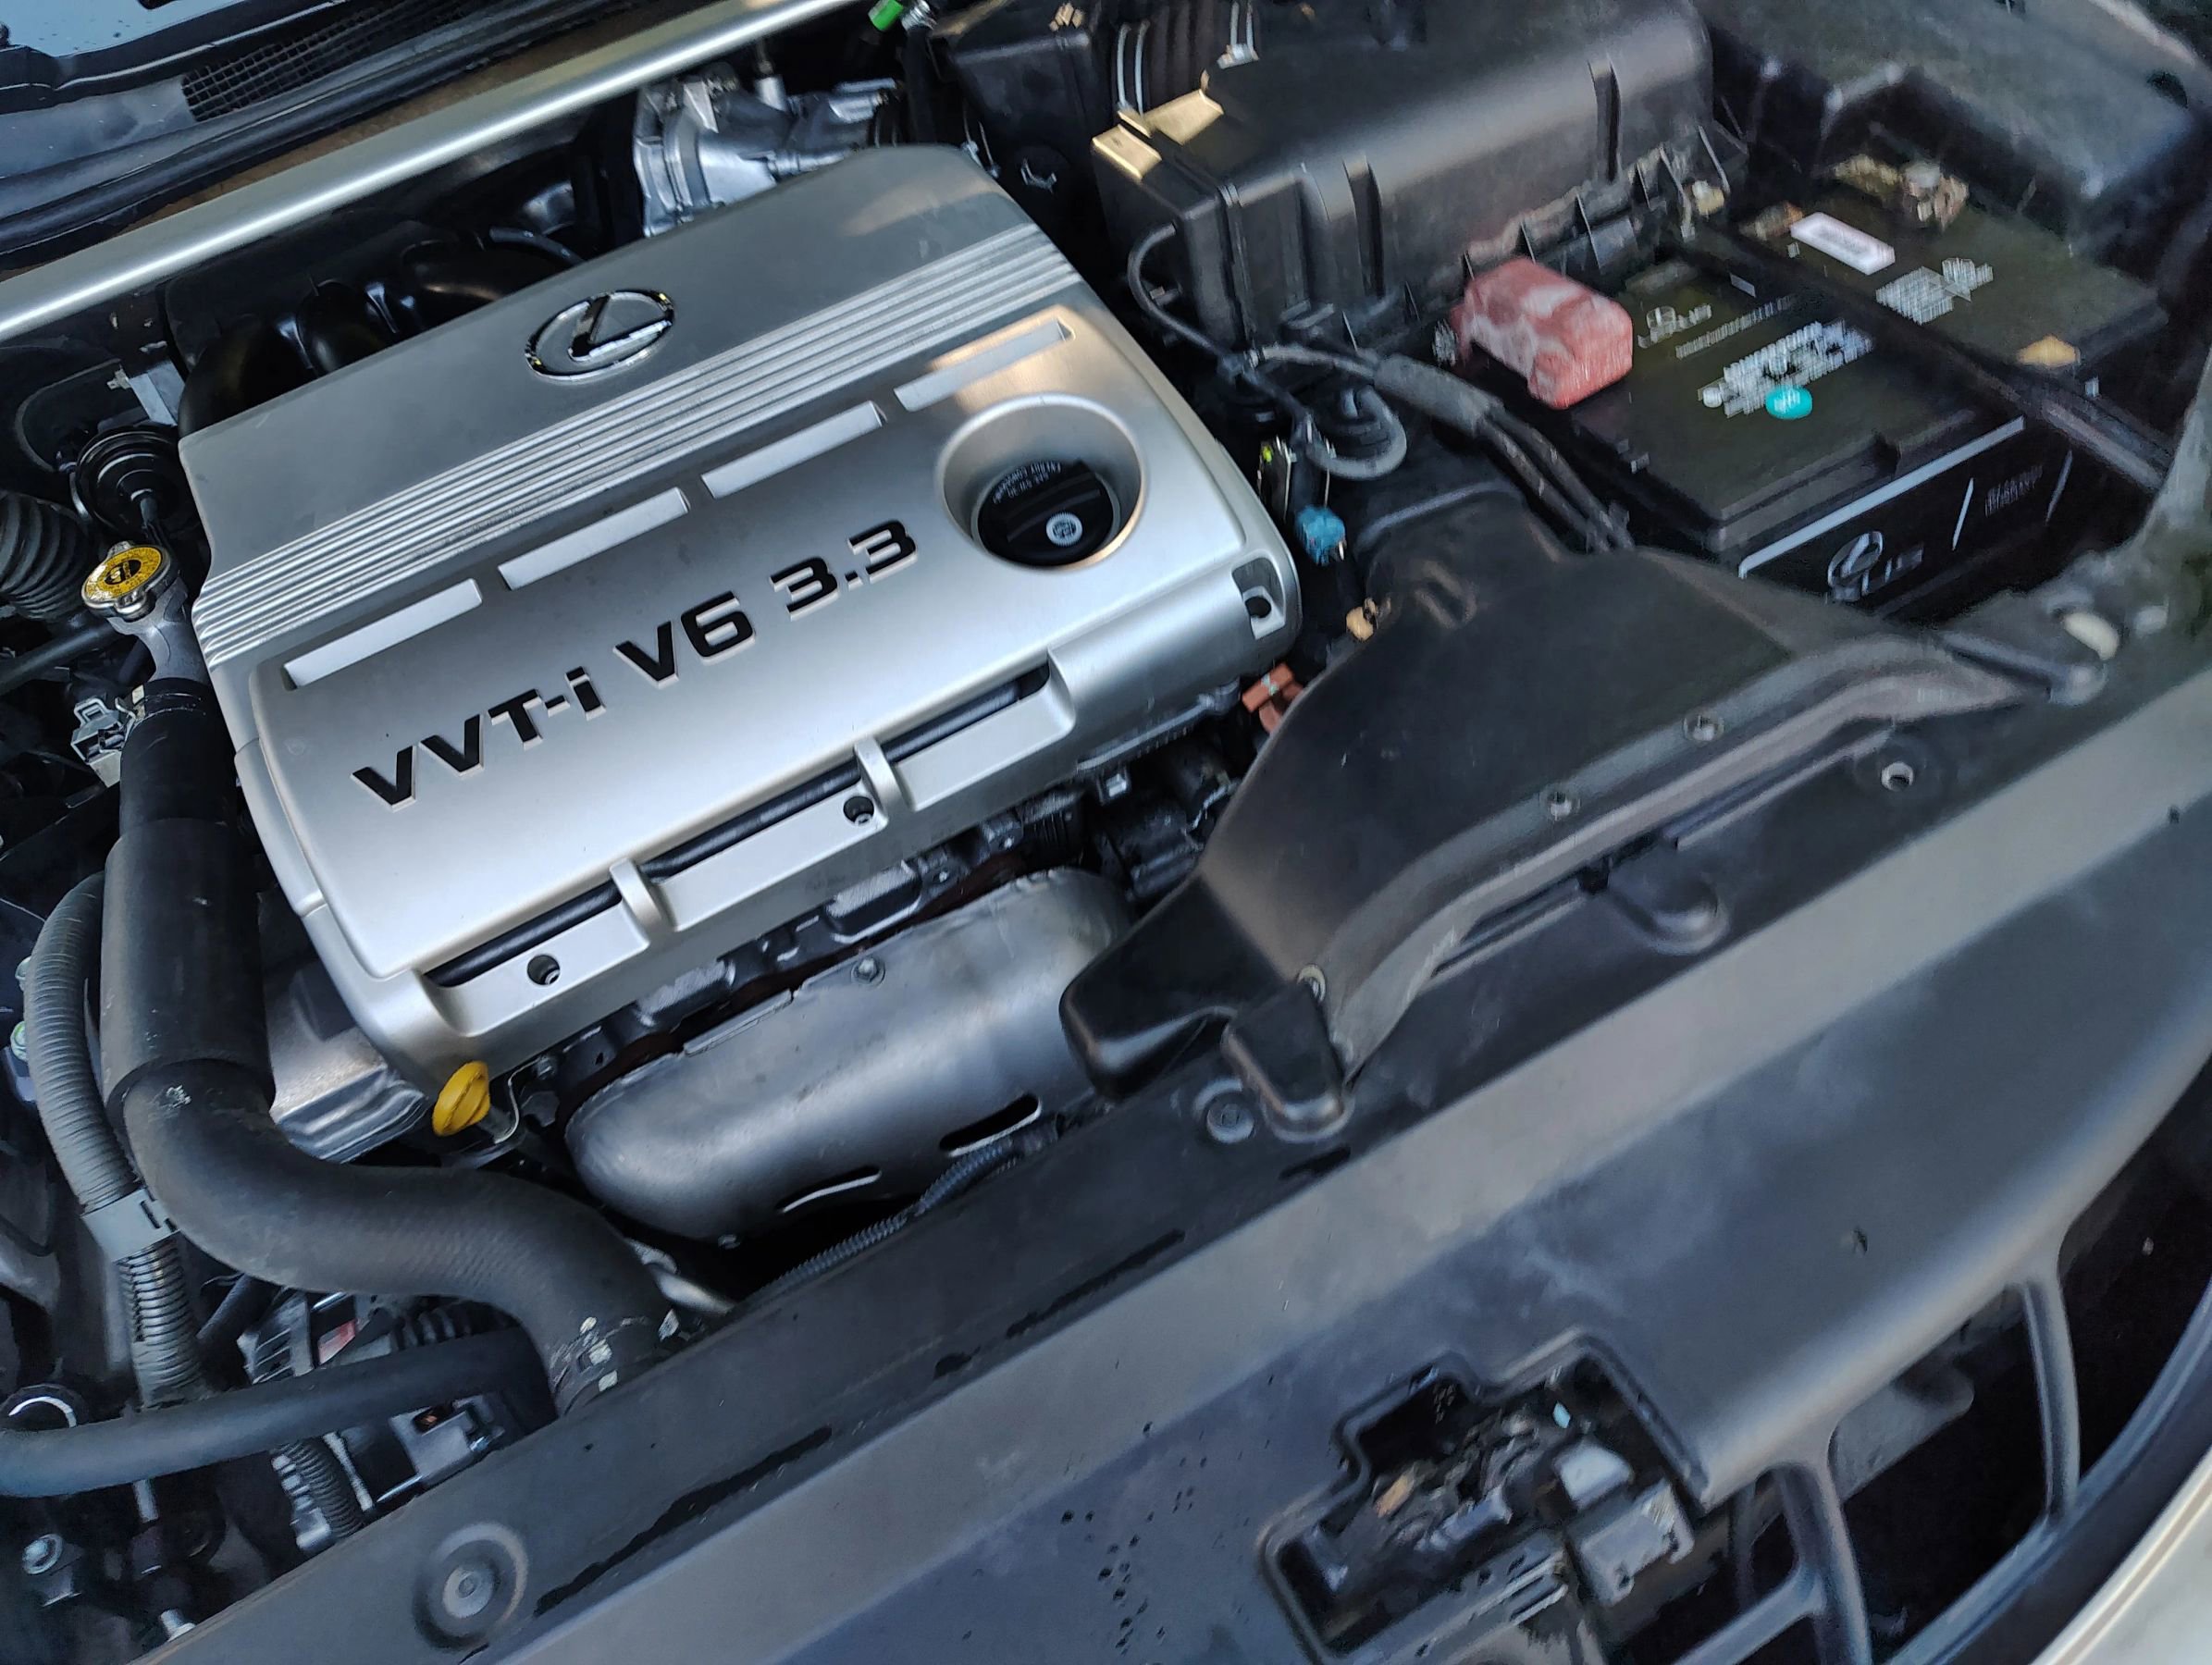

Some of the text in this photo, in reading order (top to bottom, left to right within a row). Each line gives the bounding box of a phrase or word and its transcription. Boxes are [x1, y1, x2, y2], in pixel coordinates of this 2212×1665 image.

[351, 518, 918, 812] VVT-i V6 3.3
